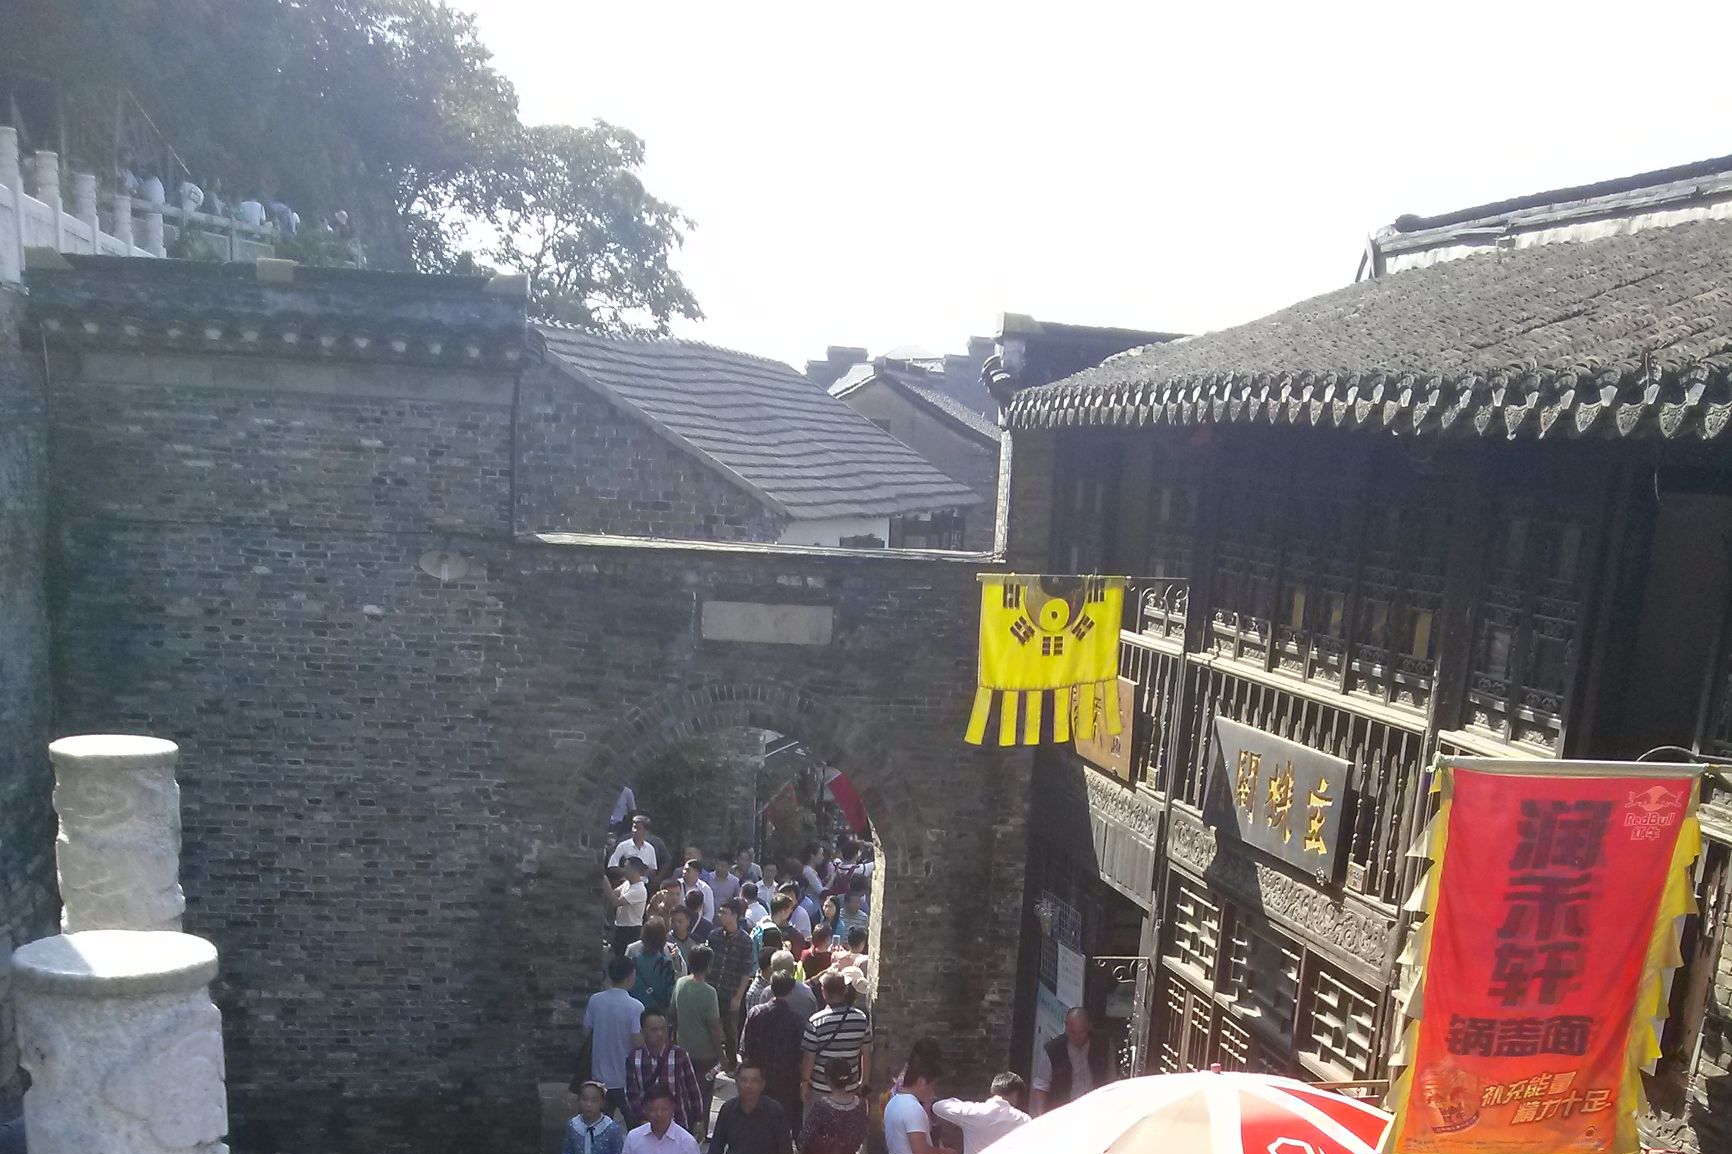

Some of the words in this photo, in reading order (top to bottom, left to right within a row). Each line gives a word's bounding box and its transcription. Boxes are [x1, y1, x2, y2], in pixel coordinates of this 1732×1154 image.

[1631, 826, 1661, 841] 红牛
[1445, 1013, 1594, 1057] 锅盖面
[1512, 1089, 1612, 1124] 精力十足
